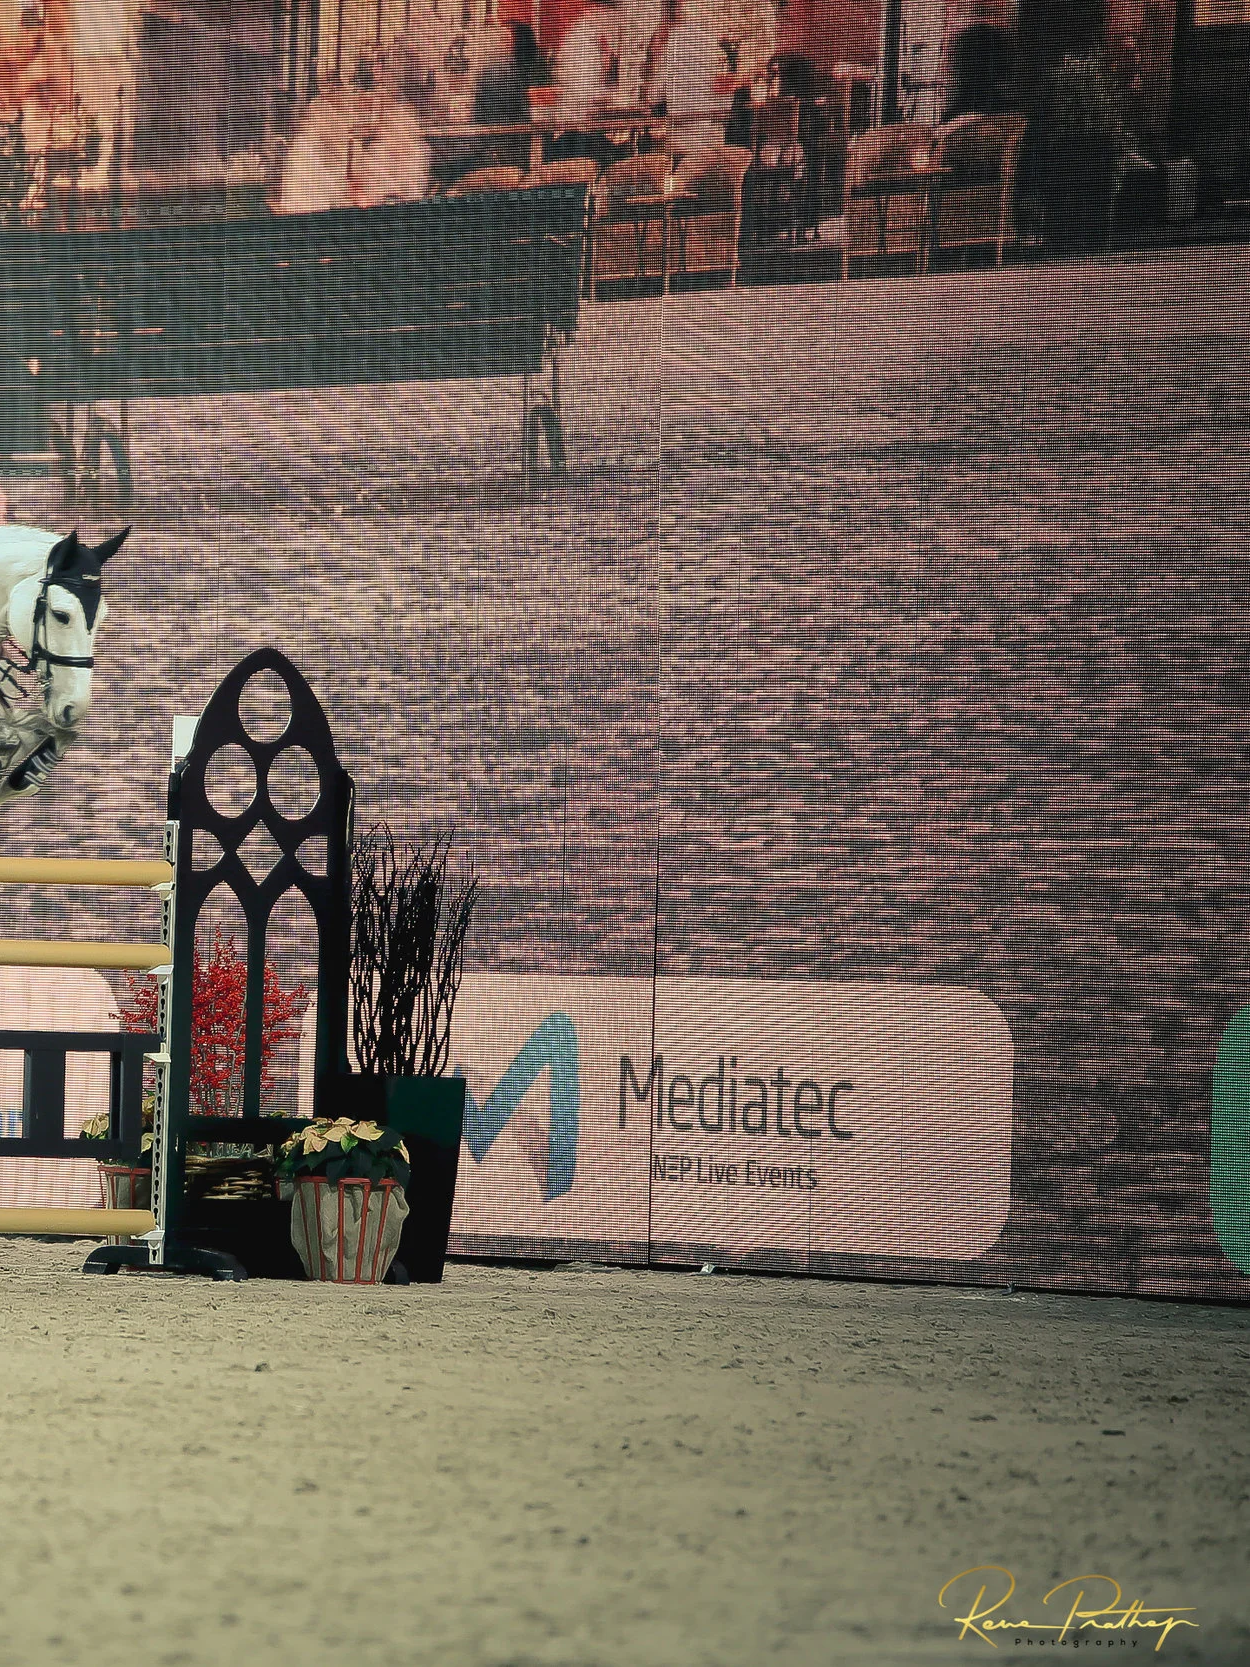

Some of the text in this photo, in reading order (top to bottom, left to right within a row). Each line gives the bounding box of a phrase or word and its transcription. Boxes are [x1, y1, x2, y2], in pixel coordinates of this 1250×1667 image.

[618, 1053, 855, 1140] Mediatec
[697, 1155, 738, 1186] Live
[746, 1160, 818, 1190] Events
